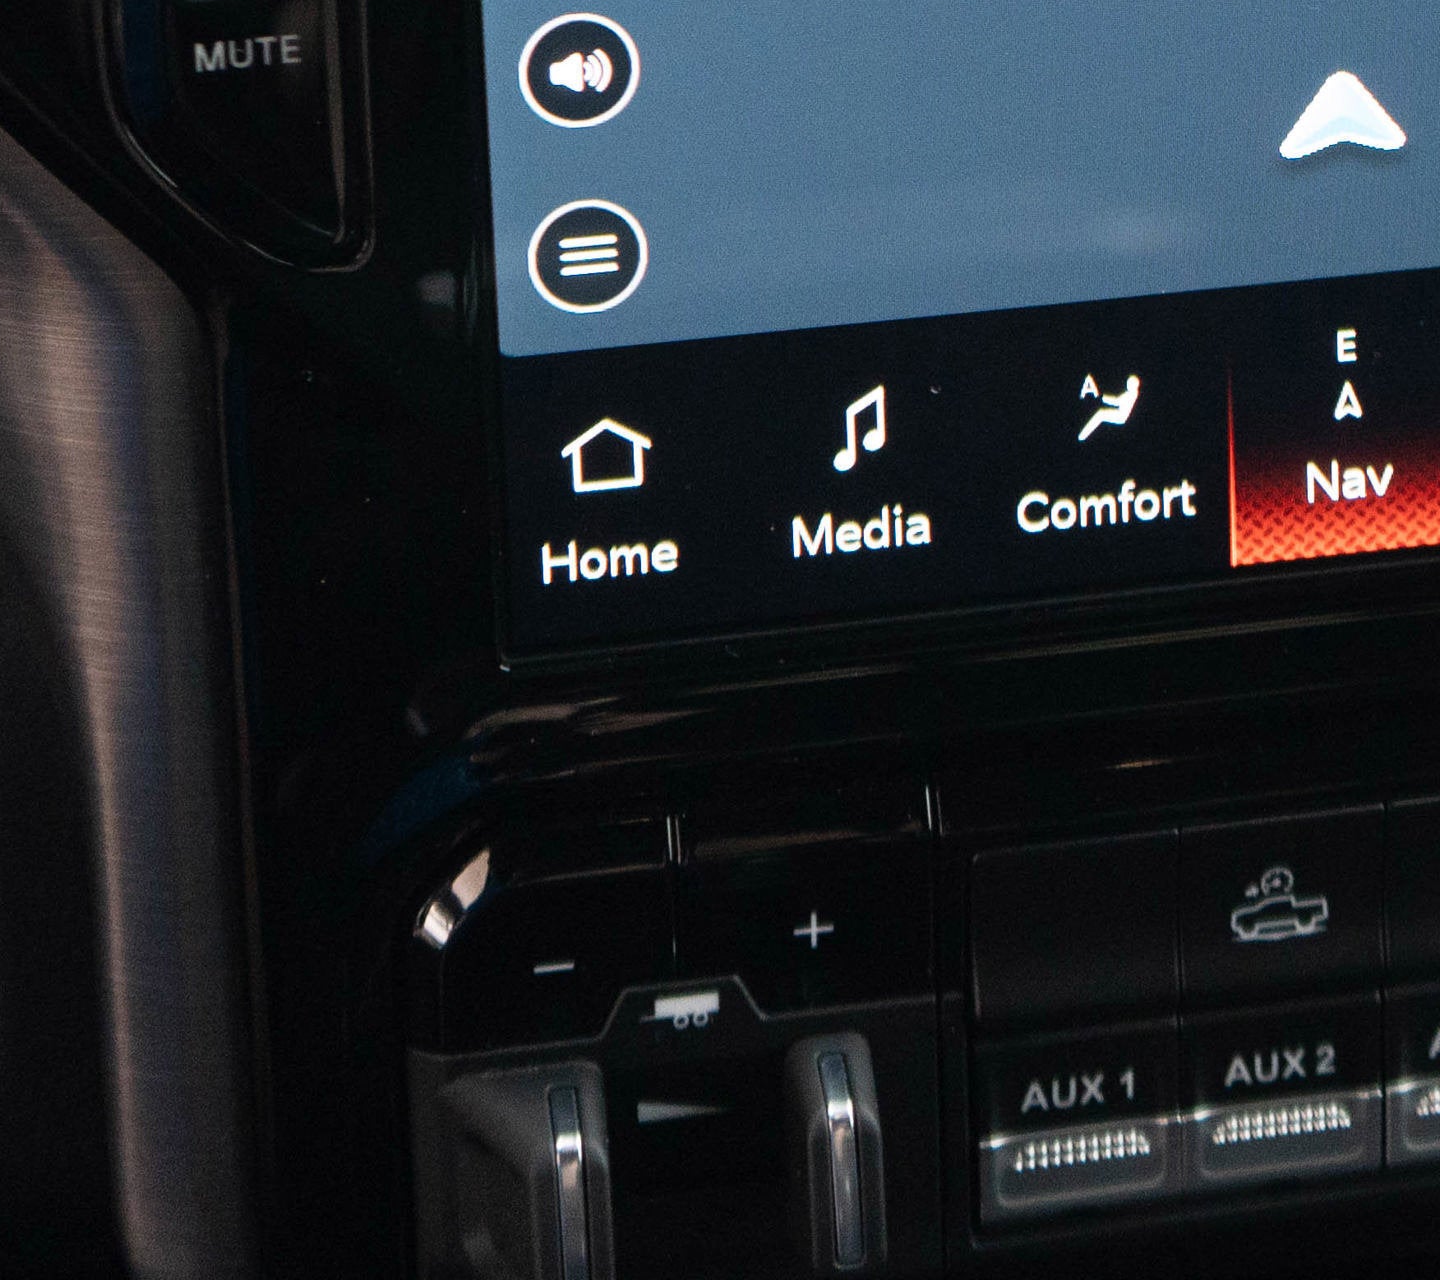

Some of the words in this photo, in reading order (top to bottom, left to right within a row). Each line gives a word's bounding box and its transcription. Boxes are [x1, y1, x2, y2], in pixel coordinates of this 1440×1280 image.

[194, 34, 303, 74] MUTE
[1335, 328, 1358, 363] E
[1305, 459, 1394, 503] Nav
[1016, 477, 1198, 534] Comfort
[791, 503, 933, 559] Media
[541, 537, 680, 586] Home
[1224, 1050, 1309, 1089] AUX
[1315, 1045, 1336, 1077] 2
[1020, 1074, 1107, 1114] AUX
[1118, 1068, 1136, 1100] 1
